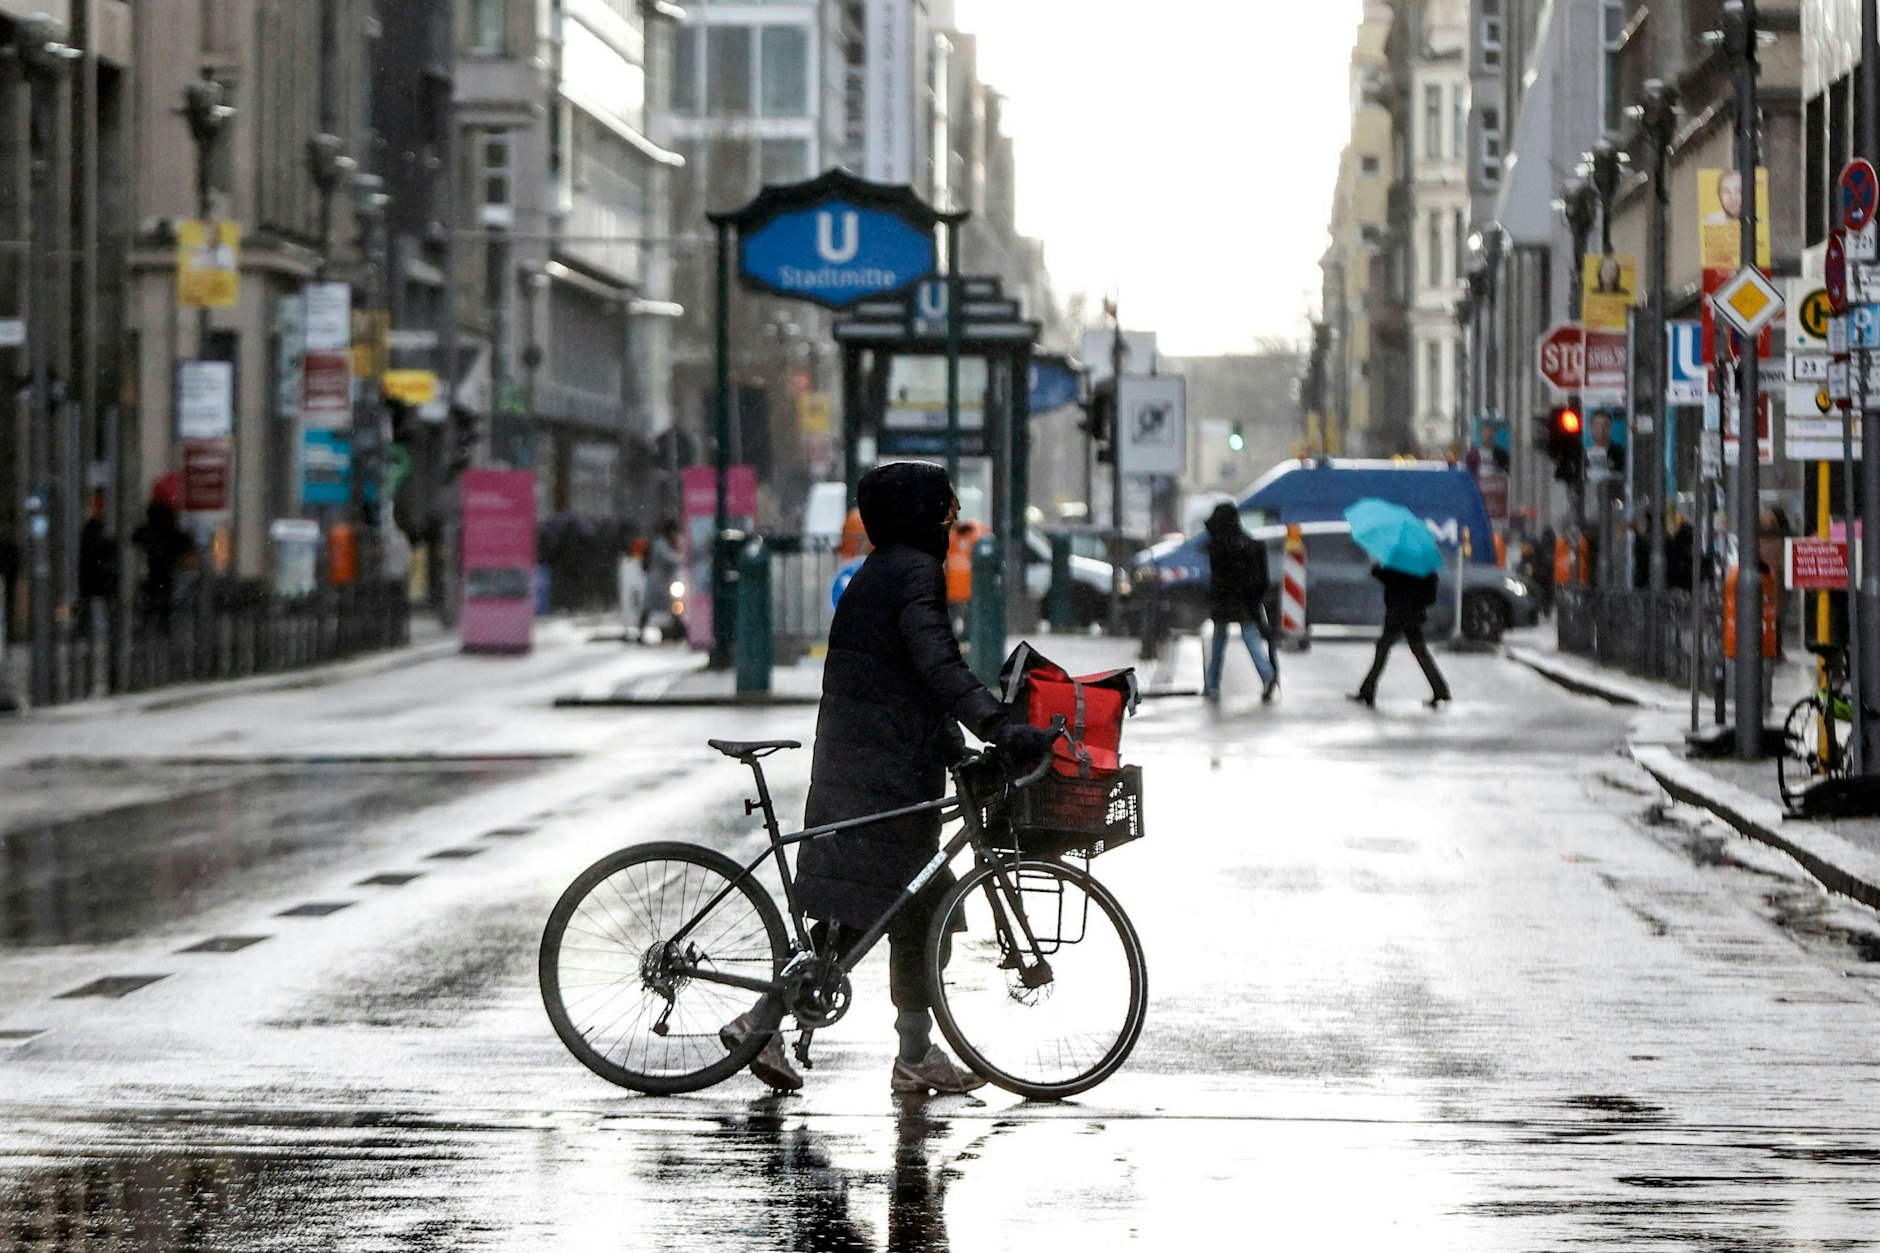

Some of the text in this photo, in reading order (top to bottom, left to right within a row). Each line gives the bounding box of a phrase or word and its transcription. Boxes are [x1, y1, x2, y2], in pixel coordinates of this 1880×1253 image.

[816, 210, 859, 263] U
[778, 264, 897, 290] Stadtmitte
[920, 279, 949, 316] U
[1544, 342, 1585, 379] STO
